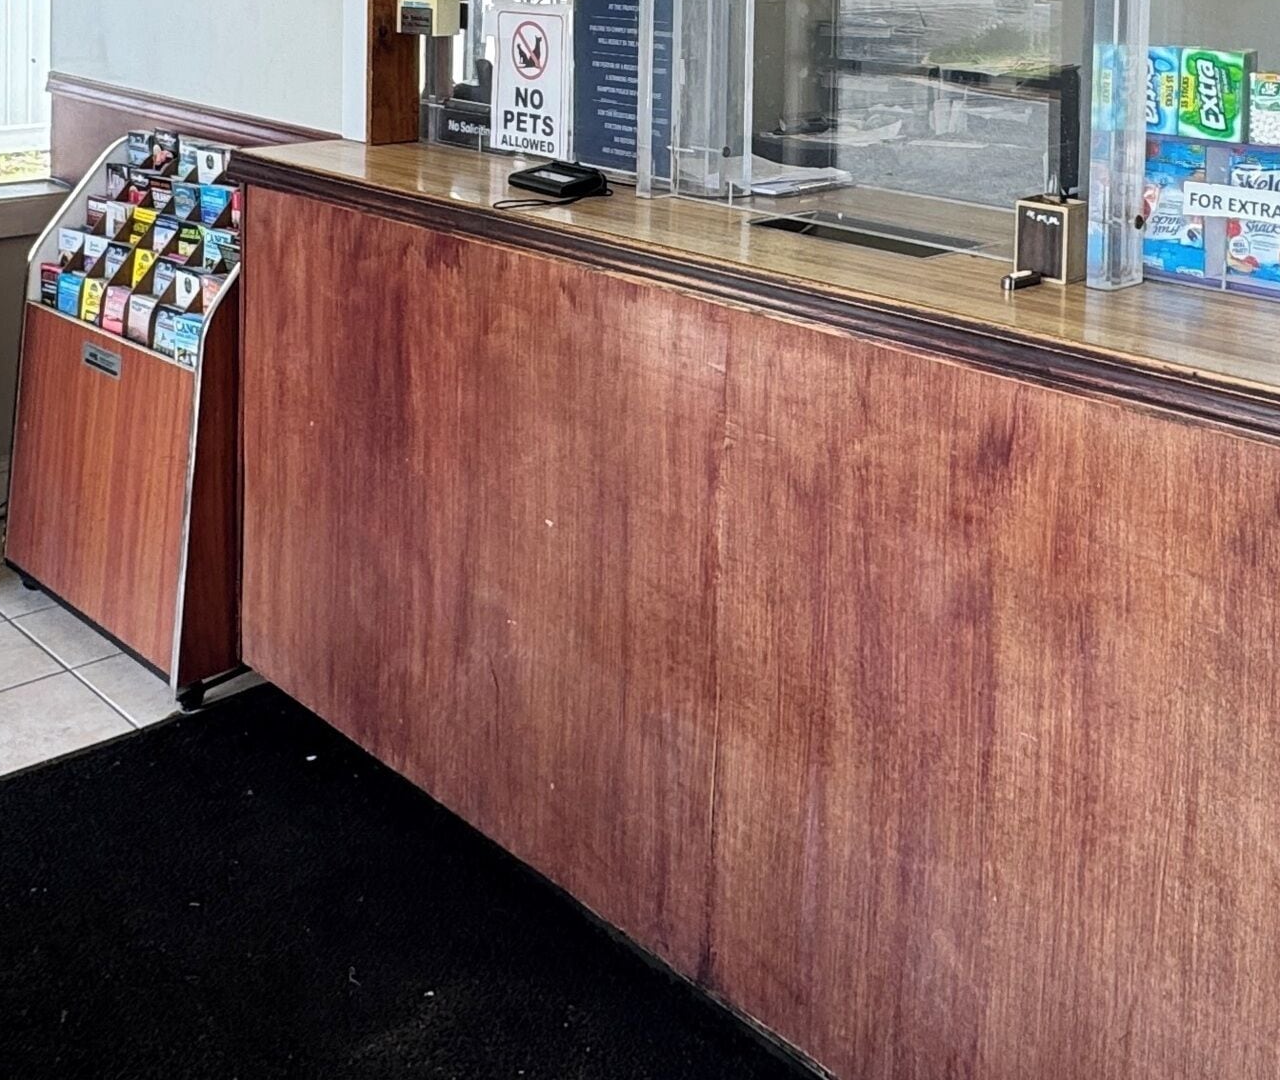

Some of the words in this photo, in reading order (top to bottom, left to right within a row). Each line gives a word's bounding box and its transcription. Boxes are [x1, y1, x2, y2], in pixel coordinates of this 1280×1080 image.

[514, 86, 544, 110] NO
[1196, 58, 1227, 131] Extra
[447, 119, 460, 132] No
[460, 121, 491, 136] Solicitin
[503, 109, 555, 137] PETS
[500, 133, 555, 154] ALLOWED
[1189, 192, 1223, 210] FOR
